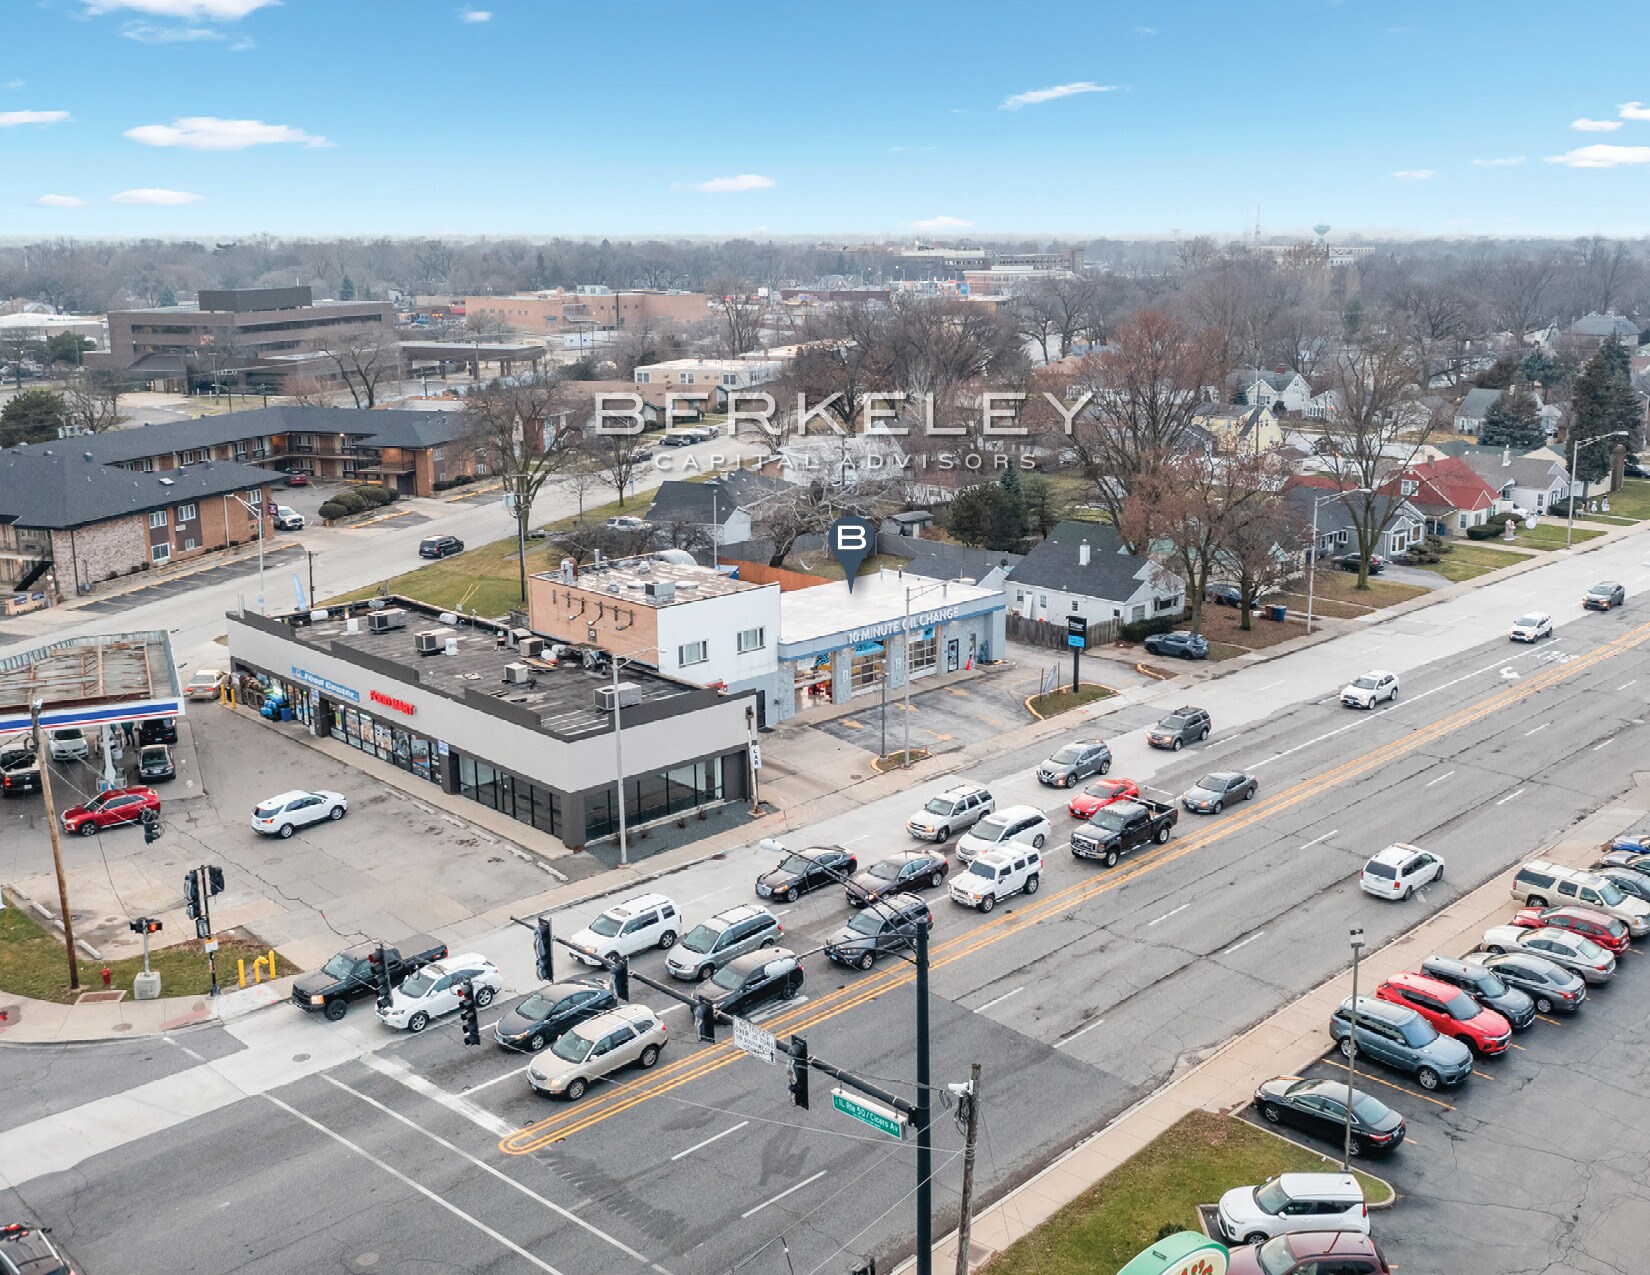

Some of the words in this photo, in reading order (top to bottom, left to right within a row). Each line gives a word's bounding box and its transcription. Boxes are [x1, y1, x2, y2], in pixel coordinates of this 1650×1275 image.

[848, 632, 860, 644] 10
[861, 620, 899, 641] MINUTE
[902, 617, 919, 630] OIL
[919, 607, 959, 626] CHANGE
[303, 672, 325, 686] Food
[369, 689, 391, 706] FOOD
[391, 699, 415, 715] MART
[838, 1098, 845, 1108] IL
[846, 1101, 856, 1113] Rte
[889, 1122, 899, 1132] Av
